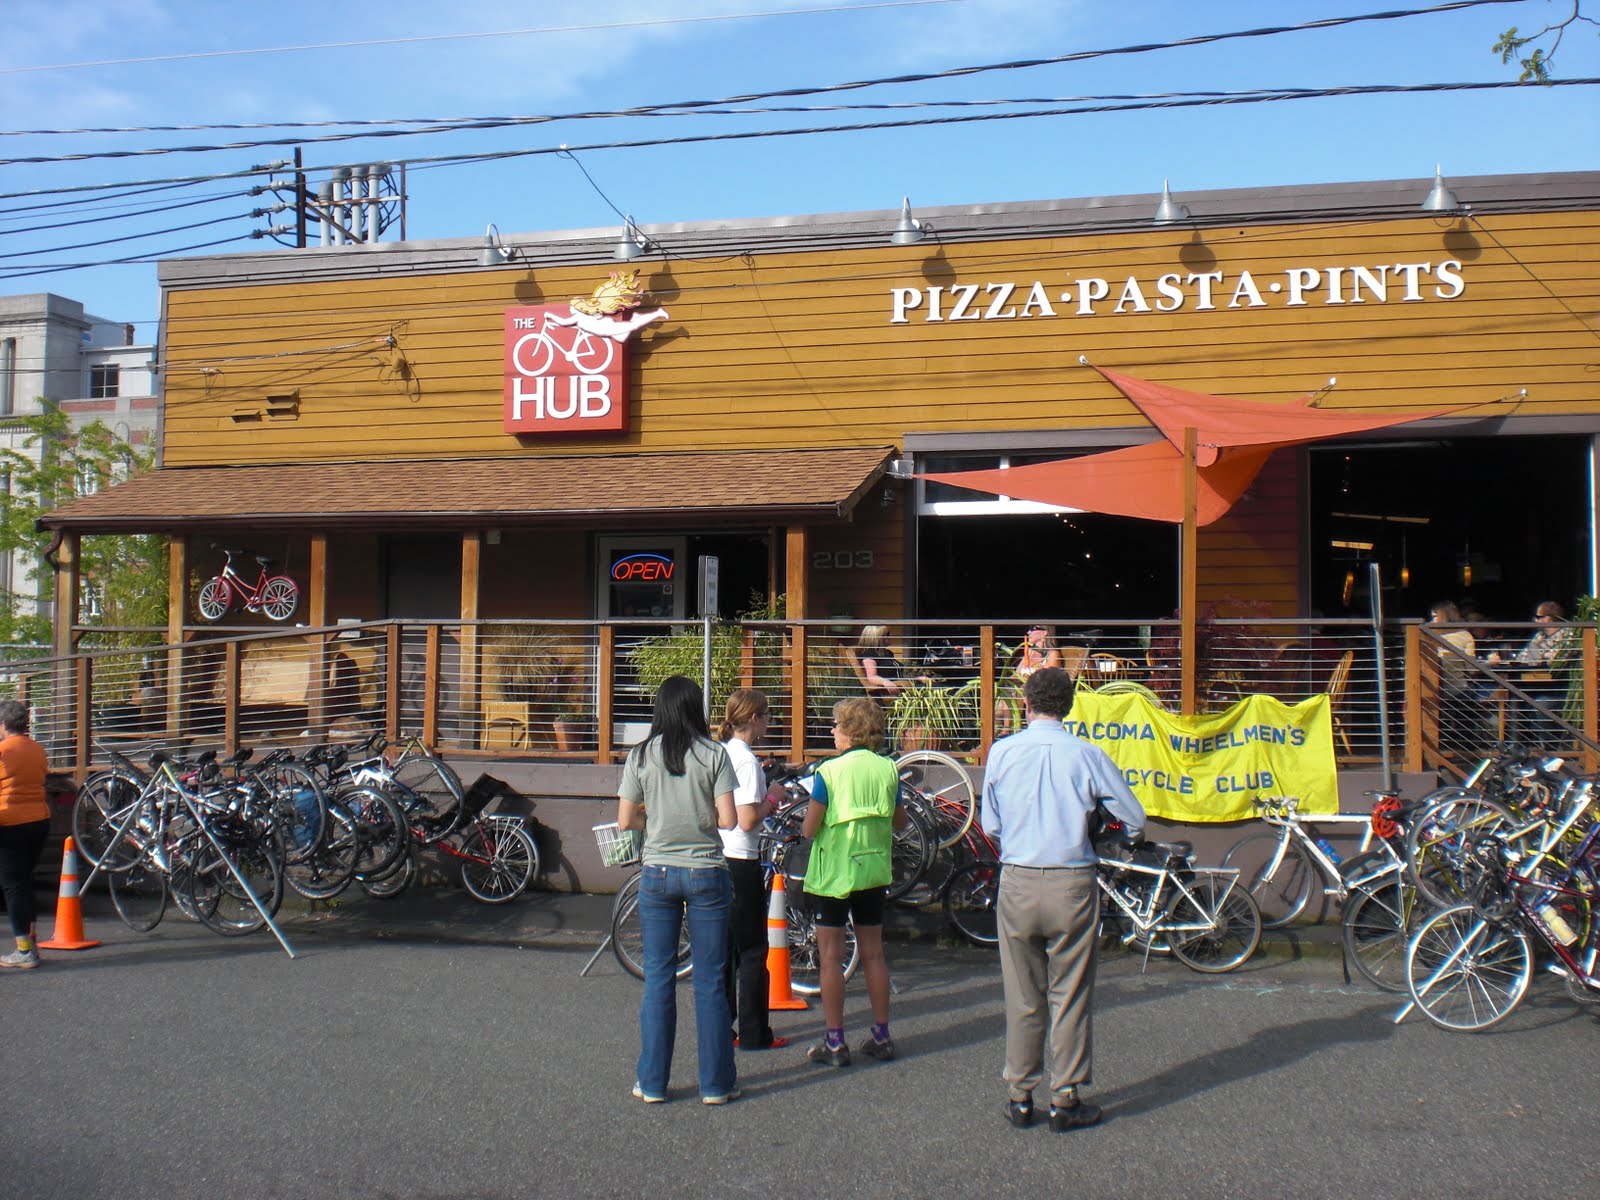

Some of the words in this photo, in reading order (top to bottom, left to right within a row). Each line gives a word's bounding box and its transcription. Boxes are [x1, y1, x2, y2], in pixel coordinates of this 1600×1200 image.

[890, 280, 1058, 323] PIZZA
[1075, 270, 1268, 316] PASTA
[1285, 260, 1466, 306] PINTS
[513, 317, 536, 330] THE
[512, 374, 612, 420] HUB
[613, 562, 675, 580] OPEN
[813, 550, 874, 569] 203
[1063, 721, 1155, 740] TACOMA
[1170, 725, 1305, 753] WHEELMEN'S
[1121, 769, 1193, 793] CYCLE
[1216, 772, 1274, 793] CLUB
